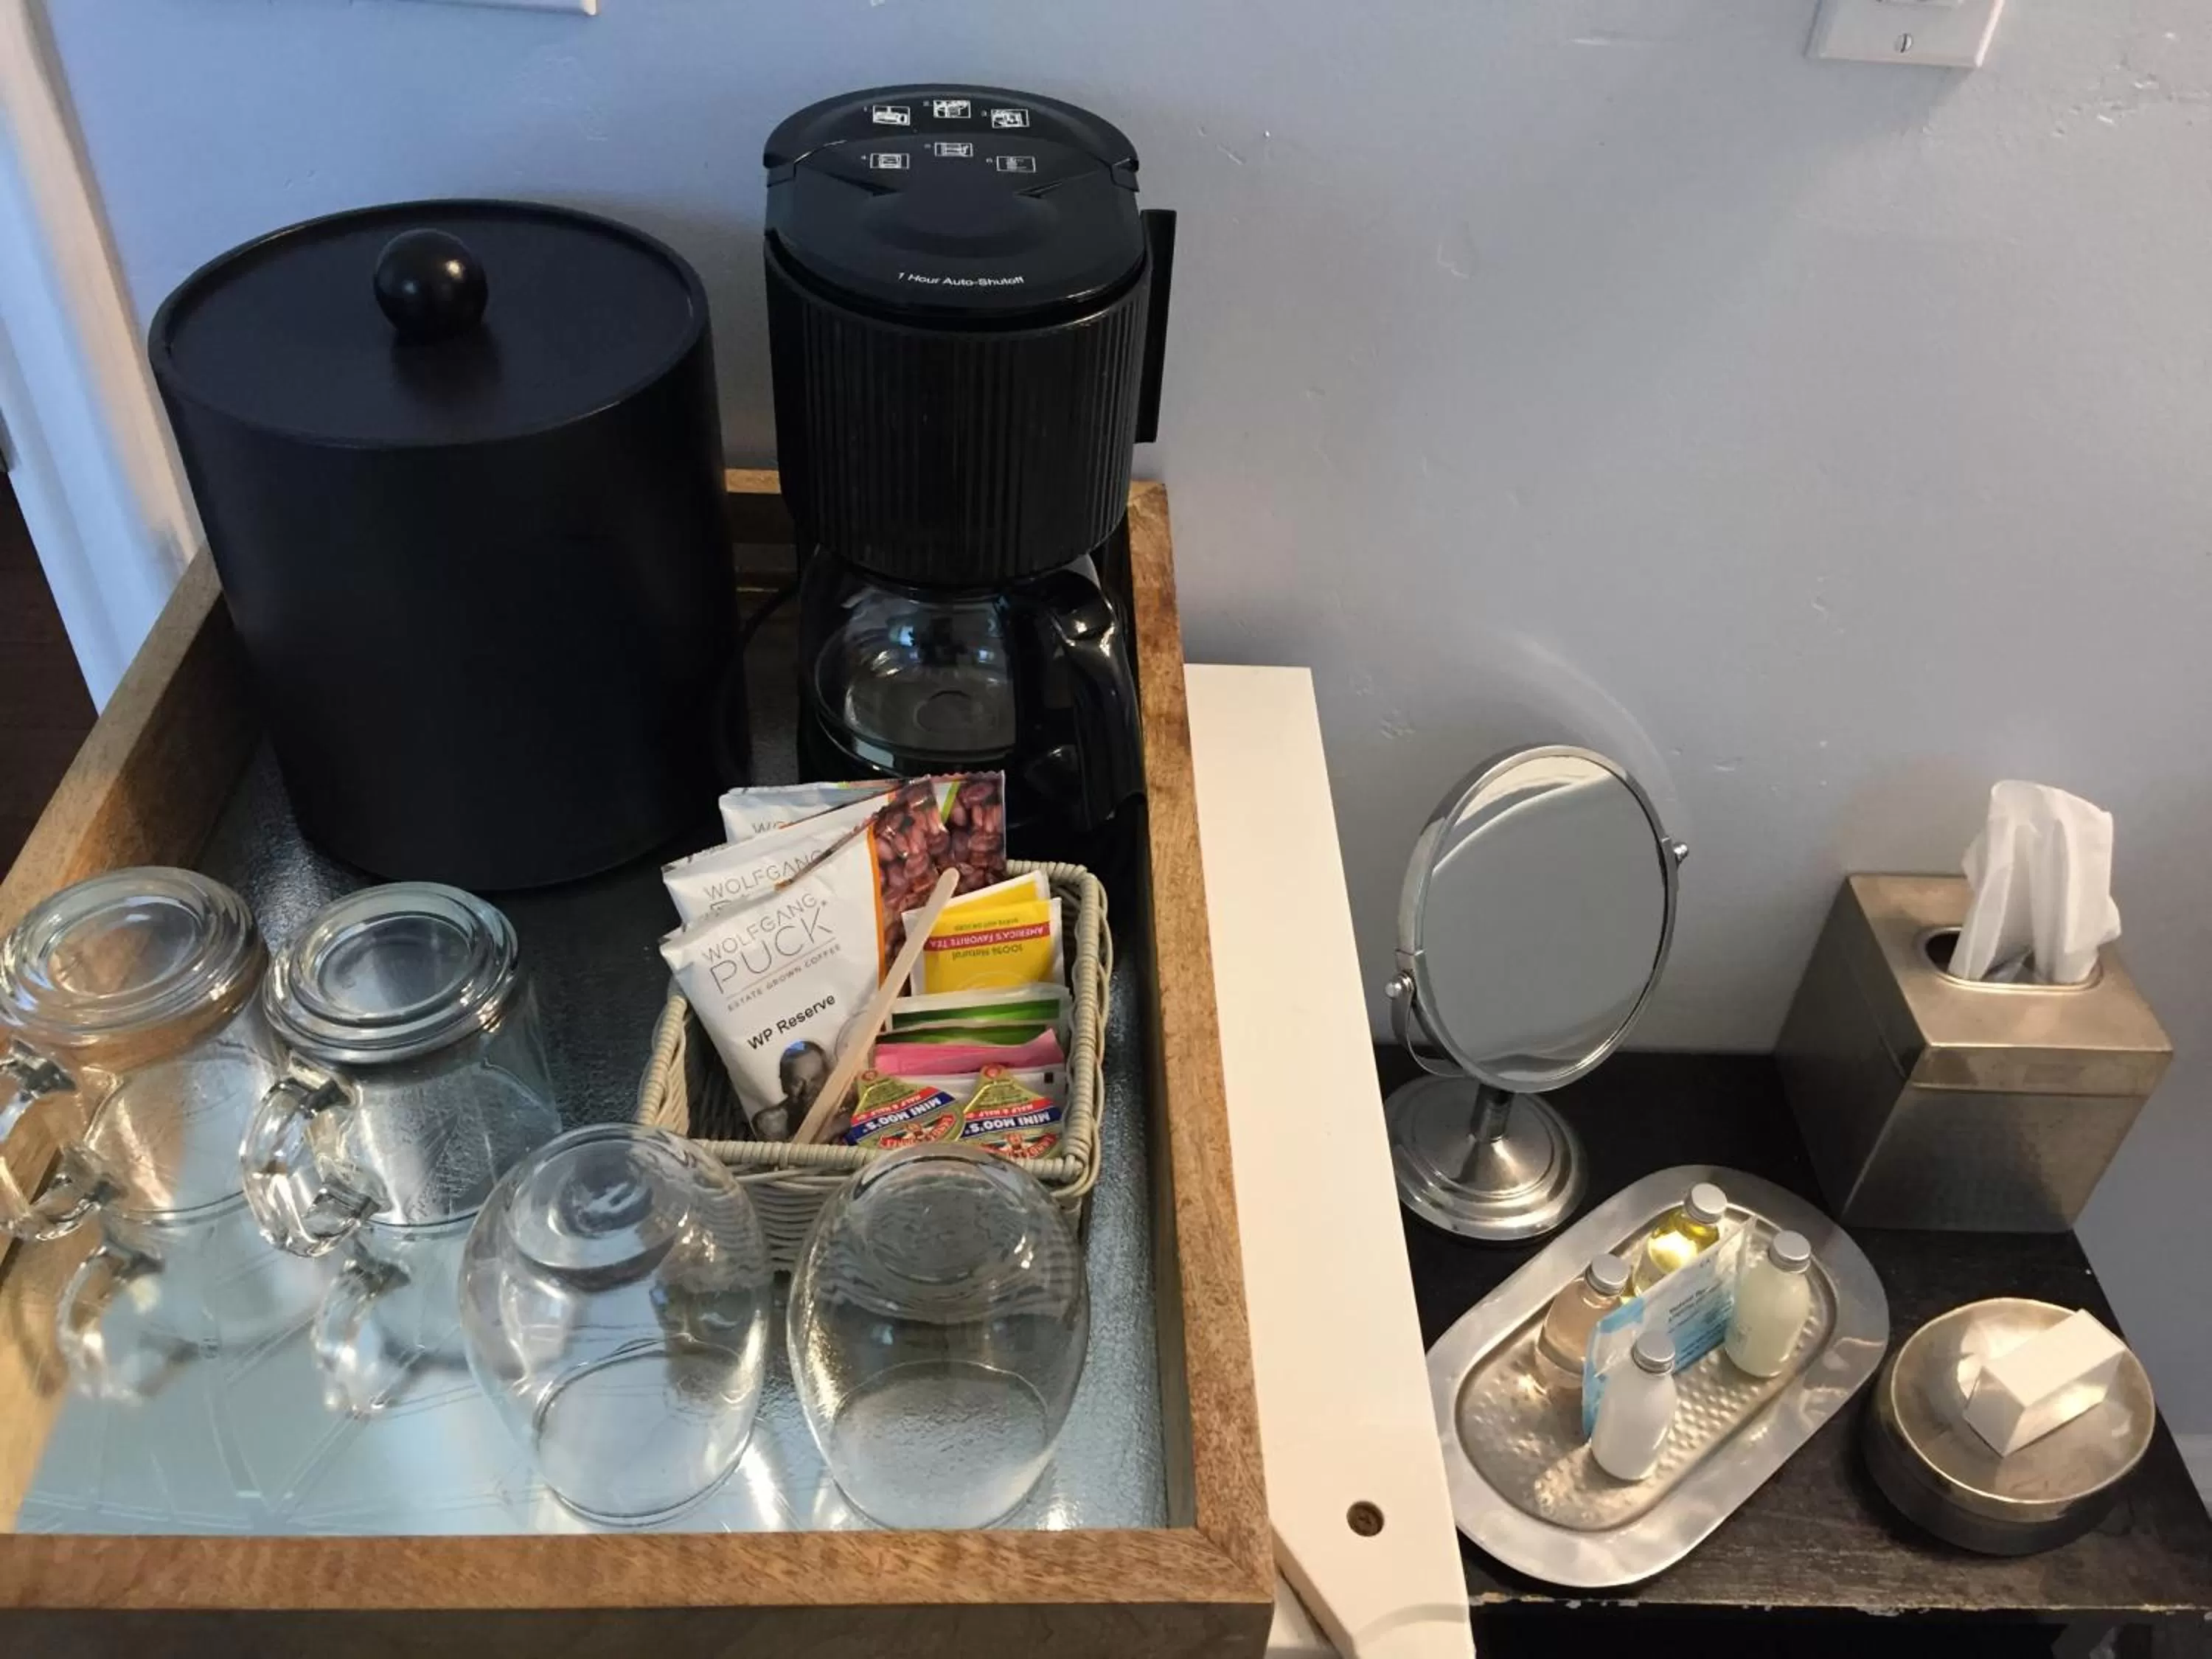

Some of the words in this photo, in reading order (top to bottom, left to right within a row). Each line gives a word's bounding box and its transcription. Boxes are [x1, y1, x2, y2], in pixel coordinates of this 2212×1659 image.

[908, 274, 940, 285] Hour
[702, 892, 817, 961] WOLFGANG
[950, 933, 993, 947] FAVORITE
[709, 907, 833, 995] PUCK
[747, 1029, 773, 1051] WP
[776, 994, 836, 1035] Reserve
[908, 1096, 942, 1116] MINI
[1017, 1111, 1051, 1125] MINI
